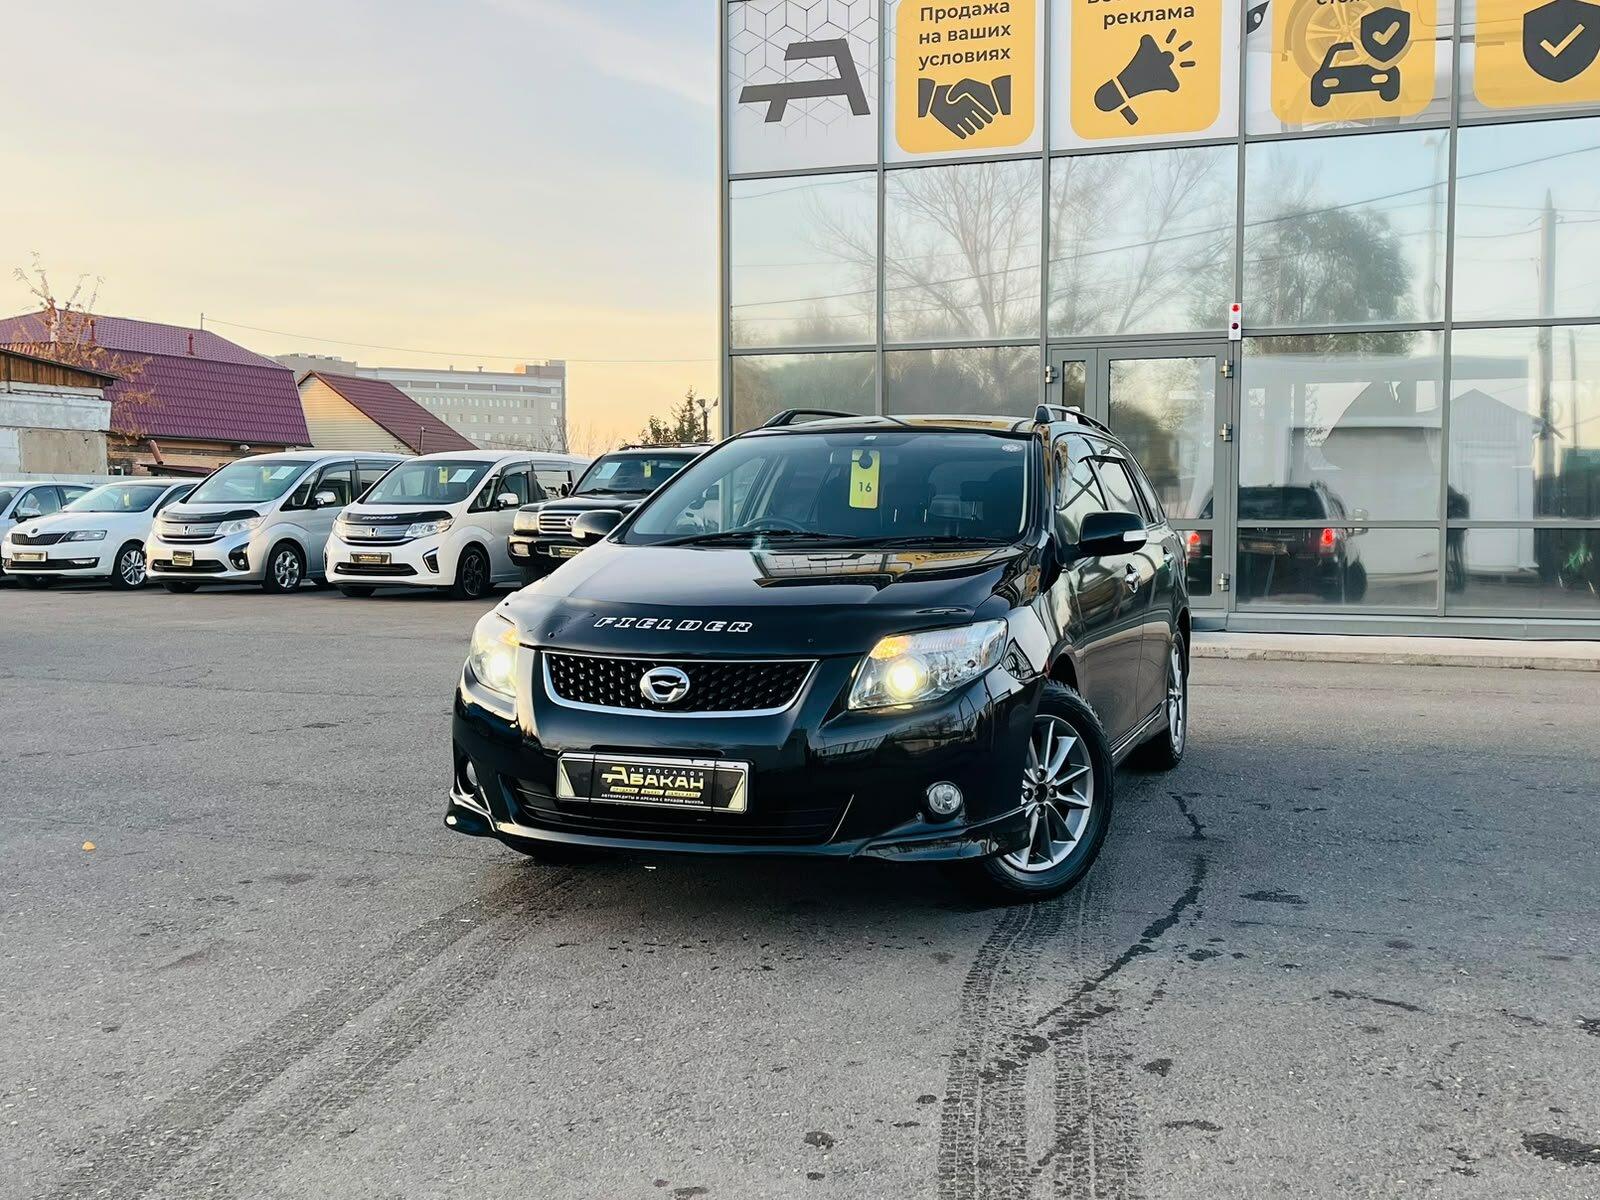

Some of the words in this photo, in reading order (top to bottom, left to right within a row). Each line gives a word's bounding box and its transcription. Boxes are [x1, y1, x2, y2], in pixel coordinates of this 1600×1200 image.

[920, 1, 1010, 24] Продажа
[1103, 5, 1195, 30] реклама
[919, 31, 941, 45] на
[947, 24, 1011, 42] ваших
[918, 47, 1011, 71] условиях
[859, 482, 872, 492] 16
[593, 617, 753, 632] FIELDER
[630, 767, 704, 777] АВТОСАЛОН
